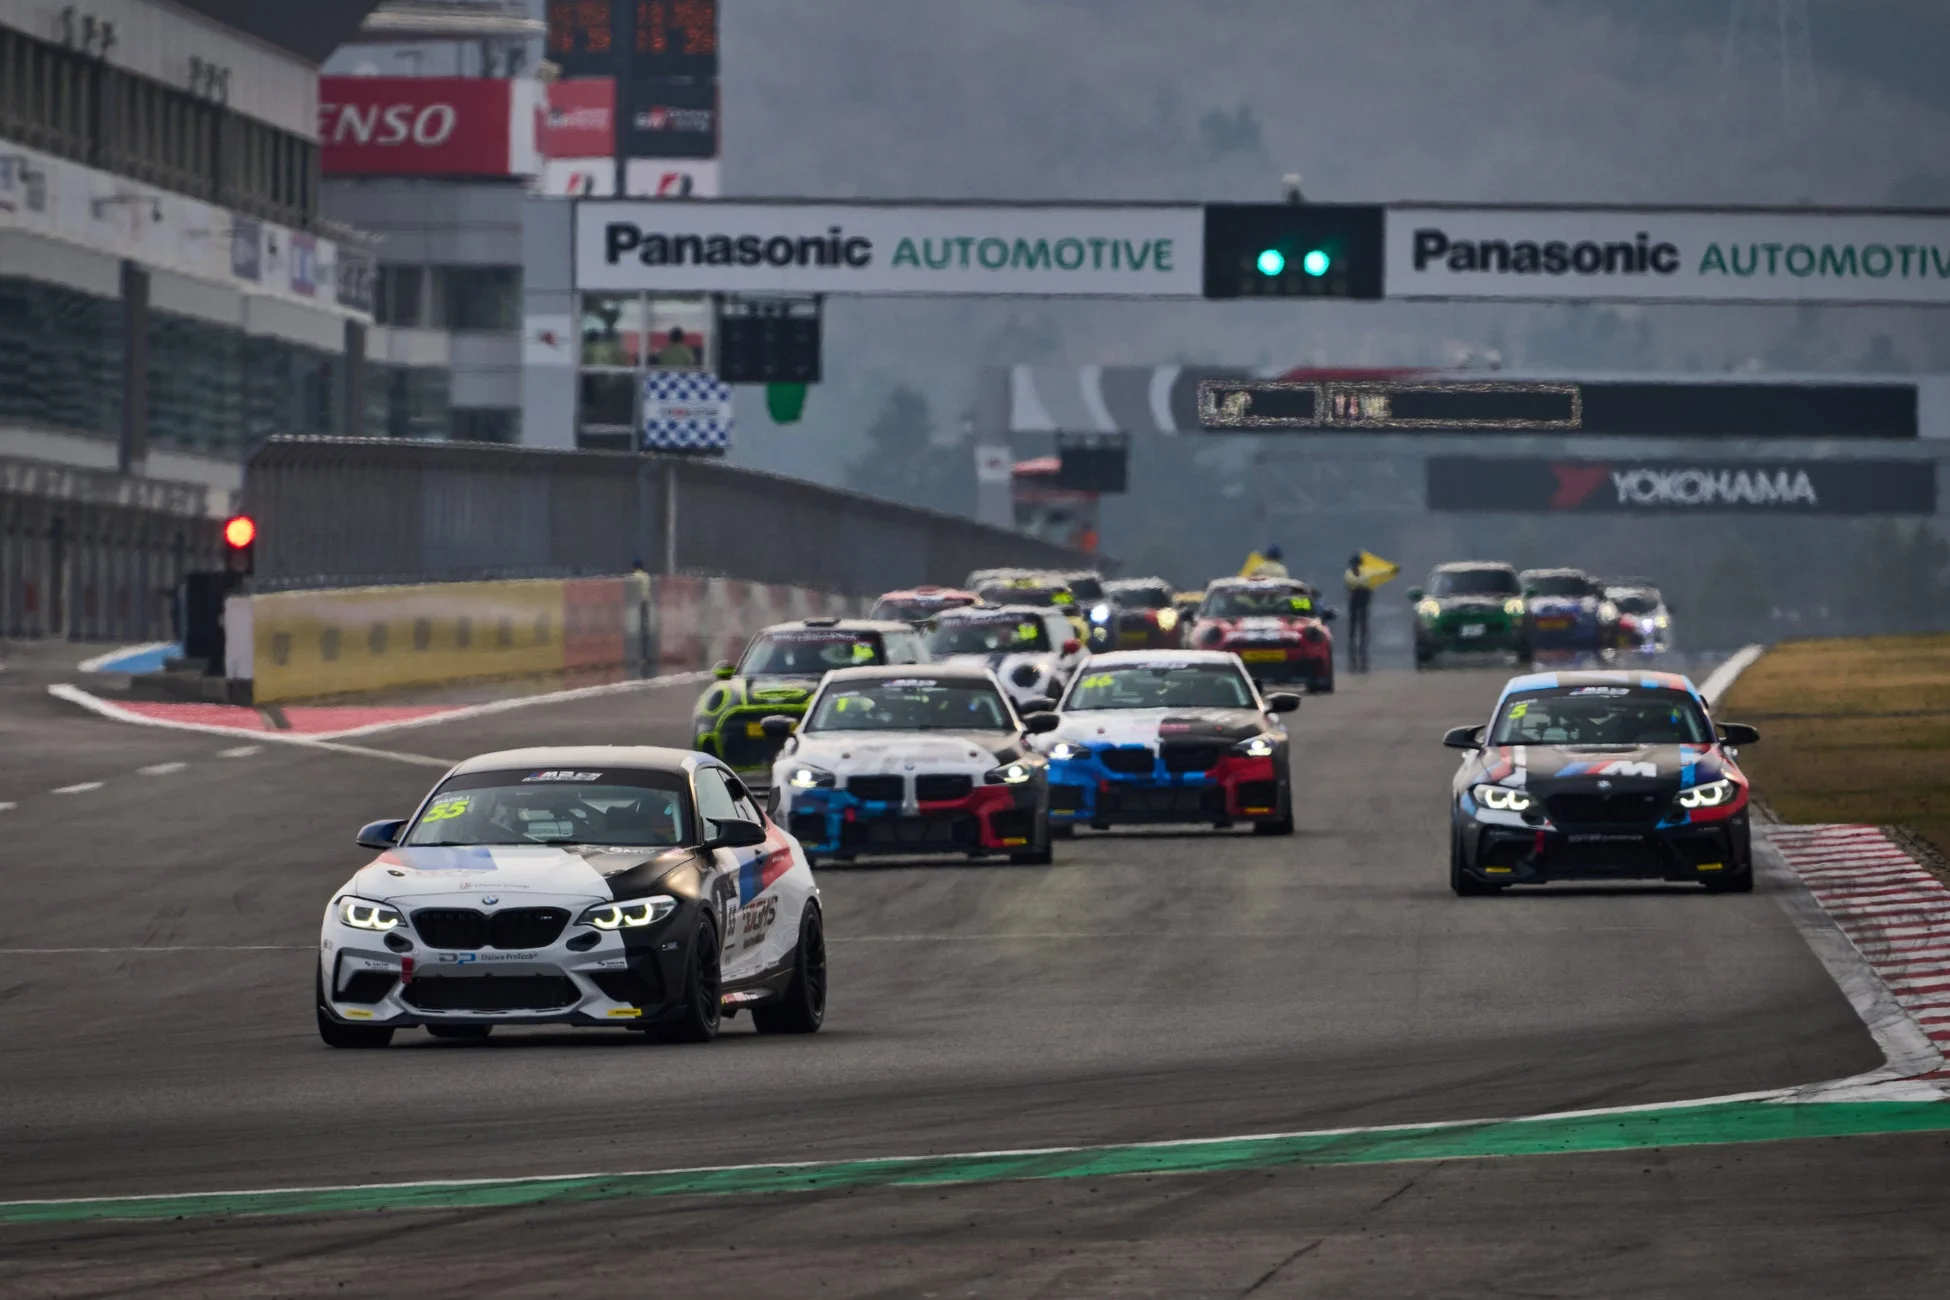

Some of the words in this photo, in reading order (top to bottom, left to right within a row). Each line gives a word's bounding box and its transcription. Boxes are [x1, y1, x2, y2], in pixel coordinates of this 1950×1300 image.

[605, 221, 873, 267] Panasonic
[892, 236, 1174, 272] AUTOMOTIVE
[1413, 228, 1681, 276] Panasonic
[1611, 469, 1817, 506] YOKOHAMA
[1508, 703, 1529, 719] 5
[422, 799, 470, 823] 55
